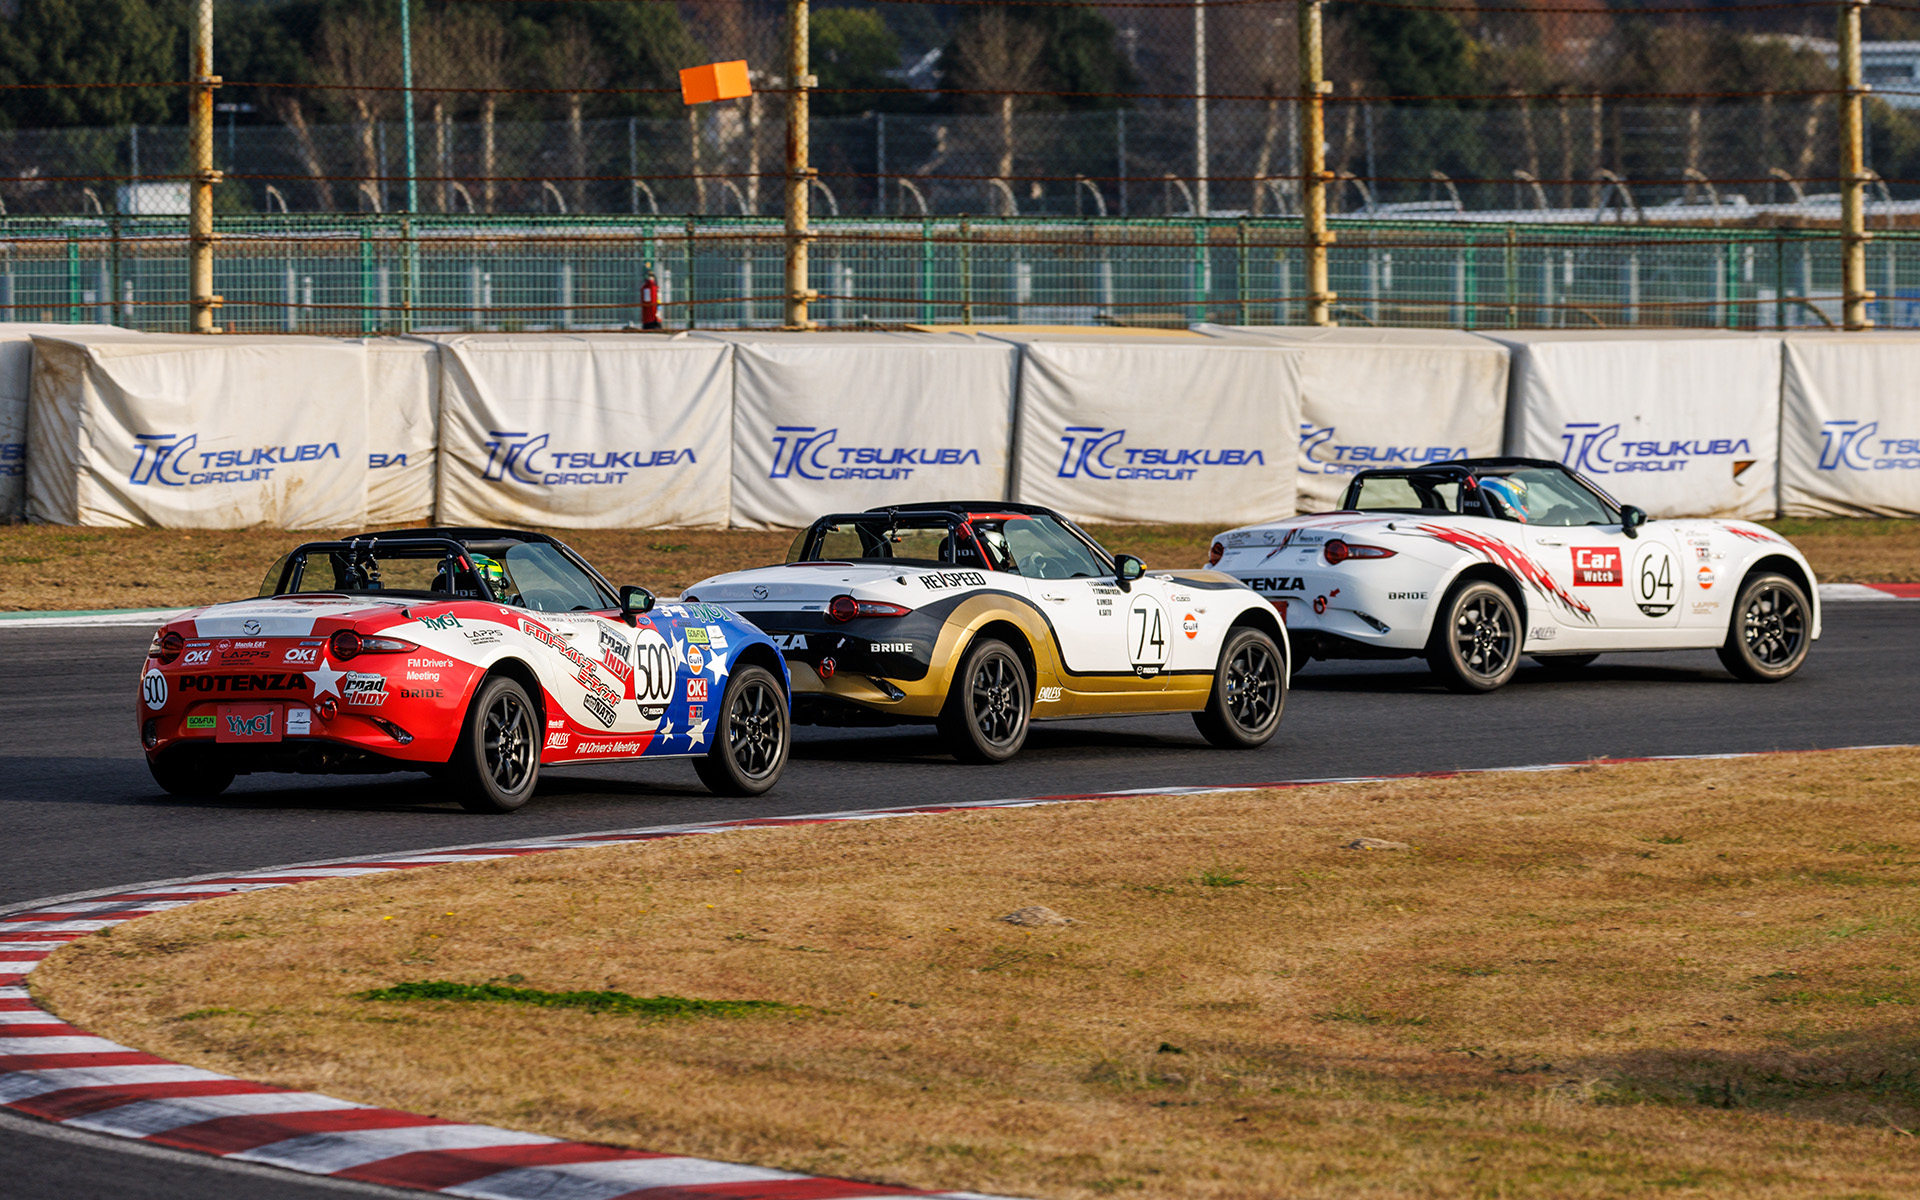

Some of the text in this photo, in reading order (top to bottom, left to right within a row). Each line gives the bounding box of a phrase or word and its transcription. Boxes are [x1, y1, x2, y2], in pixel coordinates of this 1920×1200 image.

[769, 426, 837, 480] TC
[1057, 427, 1126, 480] TC
[1334, 446, 1468, 462] TSUKUBA
[1561, 423, 1620, 473] TC
[1621, 439, 1750, 457] TSUKUBA
[1818, 420, 1878, 471] TC
[129, 433, 198, 486] TC
[201, 442, 340, 469] TSUKUBA
[482, 431, 550, 485] TC
[551, 448, 696, 468] TSUKUBA
[837, 448, 981, 465] TSUKUBA
[1124, 449, 1265, 466] TSUKUBA
[1576, 549, 1617, 569] Car
[1243, 577, 1305, 591] TENZA
[1583, 570, 1614, 582] Watch
[1641, 554, 1673, 601] 64
[1388, 591, 1428, 600] BRIDE
[1134, 608, 1164, 660] 74
[1183, 620, 1198, 631] Gulf
[221, 651, 271, 659] LAPPS
[285, 649, 317, 661] OK!
[601, 631, 630, 662] road
[870, 643, 914, 653] BRIDE
[184, 650, 213, 662] OK!
[408, 659, 454, 668] FM Driver's
[604, 648, 631, 680] INDY
[689, 656, 702, 665] Gulf
[407, 671, 440, 682] Meeting
[637, 643, 672, 700] 500
[144, 675, 166, 704] 500
[179, 673, 308, 692] POTENZA
[345, 679, 386, 692] road
[688, 680, 707, 697] OK!
[350, 691, 387, 705] INDY
[400, 689, 444, 699] BRIDE
[594, 701, 614, 724] NATS
[547, 733, 571, 745] ENDLESS
[575, 741, 640, 754] FM Driver's Meeting
